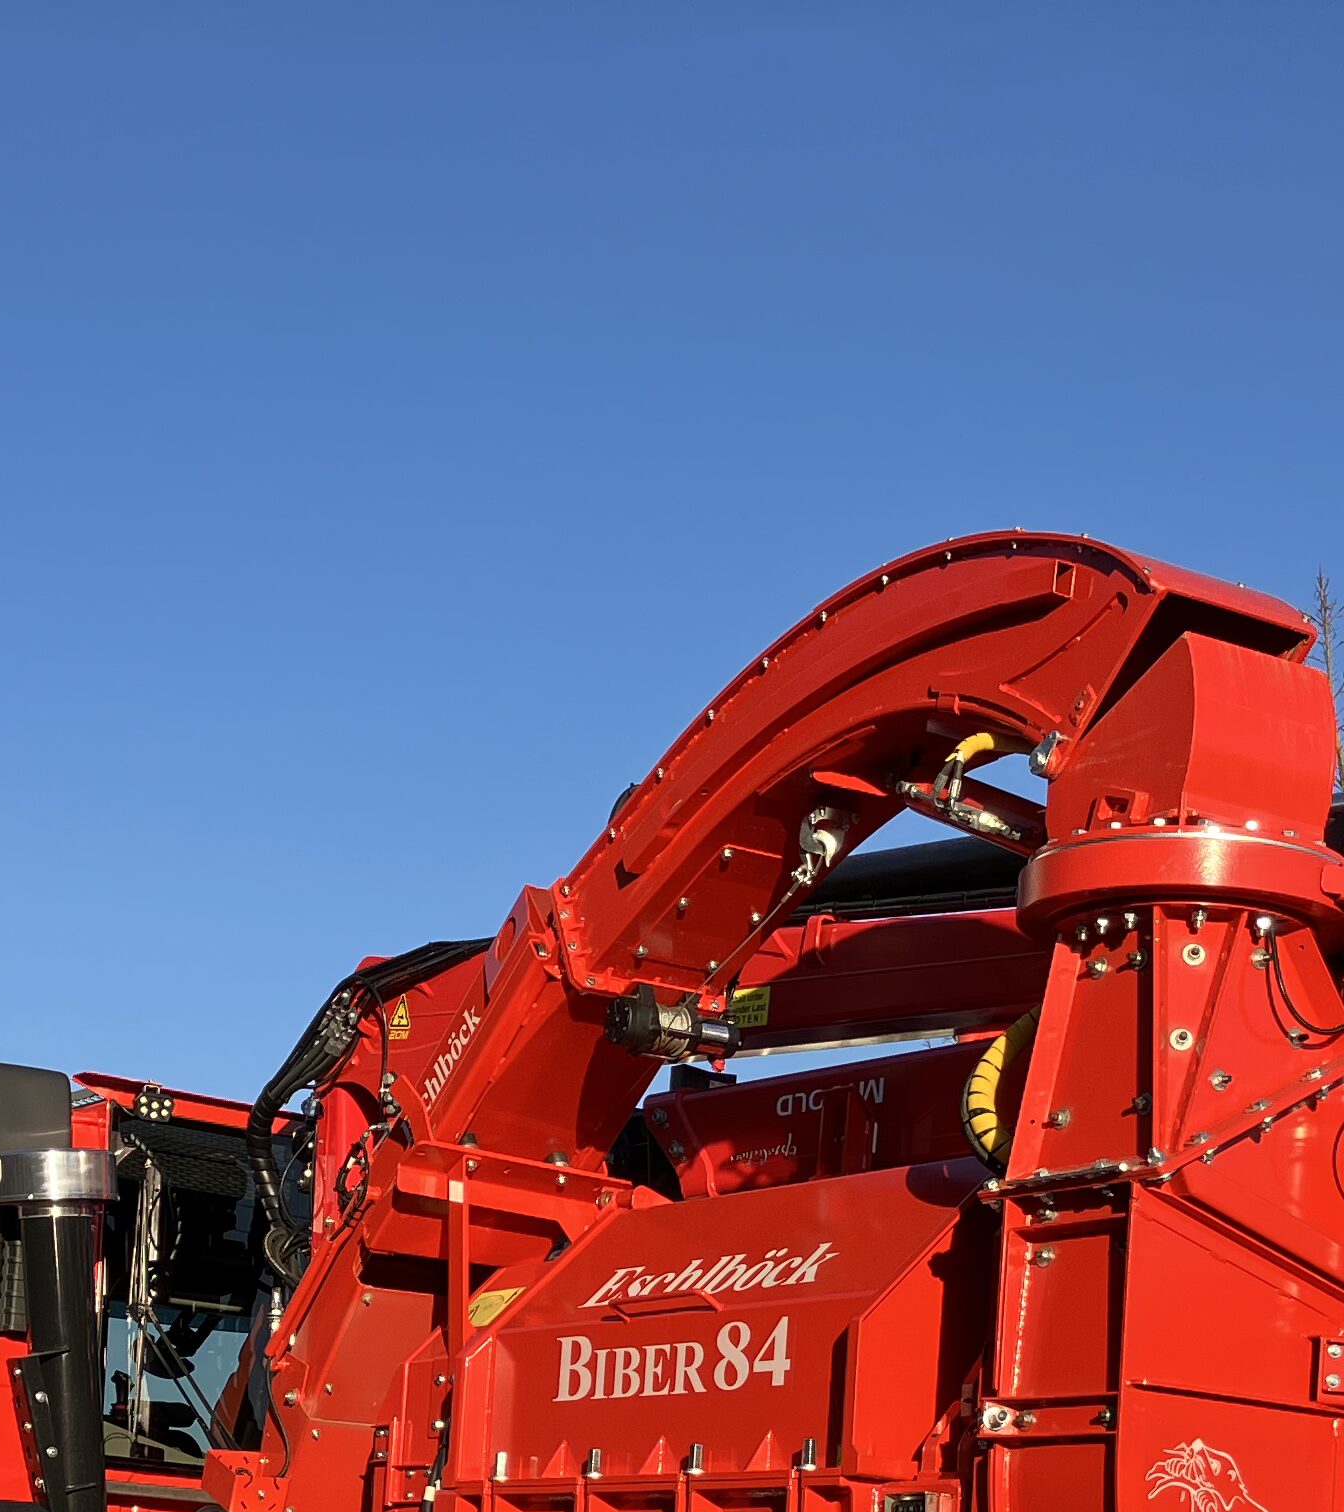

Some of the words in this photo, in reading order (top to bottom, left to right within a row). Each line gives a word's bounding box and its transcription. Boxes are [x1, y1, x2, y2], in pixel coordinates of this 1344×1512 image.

[421, 1005, 482, 1113] chlböck
[577, 1242, 840, 1309] Eschlböck
[552, 1335, 707, 1402] BIBER
[713, 1316, 791, 1391] 84
